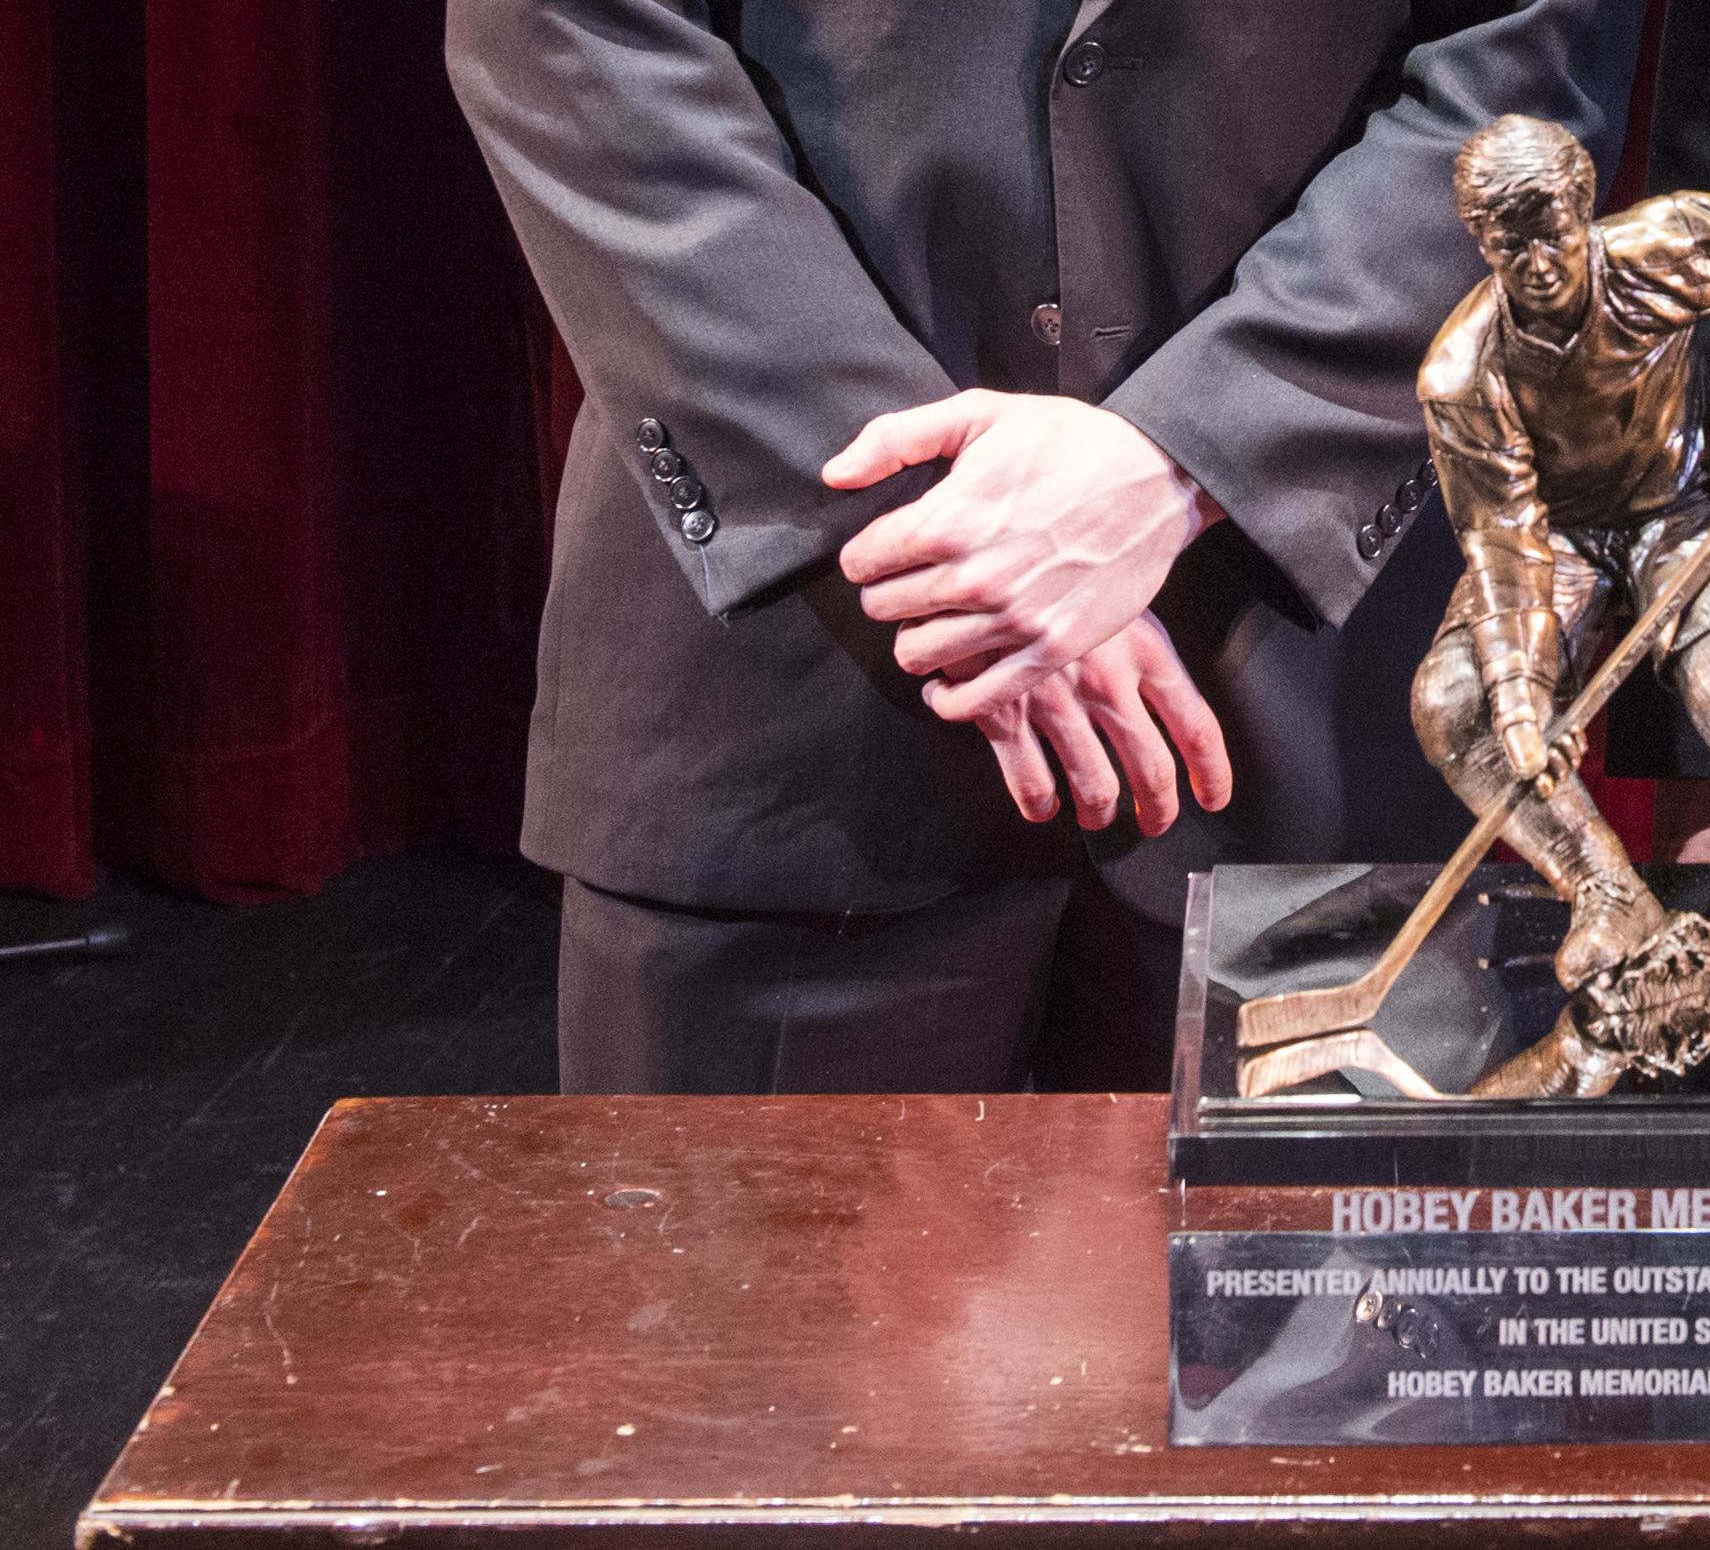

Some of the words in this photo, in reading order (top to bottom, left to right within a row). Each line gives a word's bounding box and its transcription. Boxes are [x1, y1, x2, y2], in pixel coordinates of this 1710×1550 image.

[1331, 1191, 1479, 1234] HOBEY
[1490, 1189, 1638, 1232] BAKER
[1206, 1268, 1362, 1297] PRESENTED
[1370, 1266, 1507, 1295] ANNUALLY
[1513, 1266, 1549, 1294] TO
[1556, 1266, 1608, 1294] THE
[1498, 1317, 1528, 1346] IN
[1534, 1317, 1585, 1346] THE
[1591, 1317, 1688, 1346] UNITED
[1387, 1370, 1478, 1398] HOBEY
[1483, 1369, 1573, 1397] BAKER
